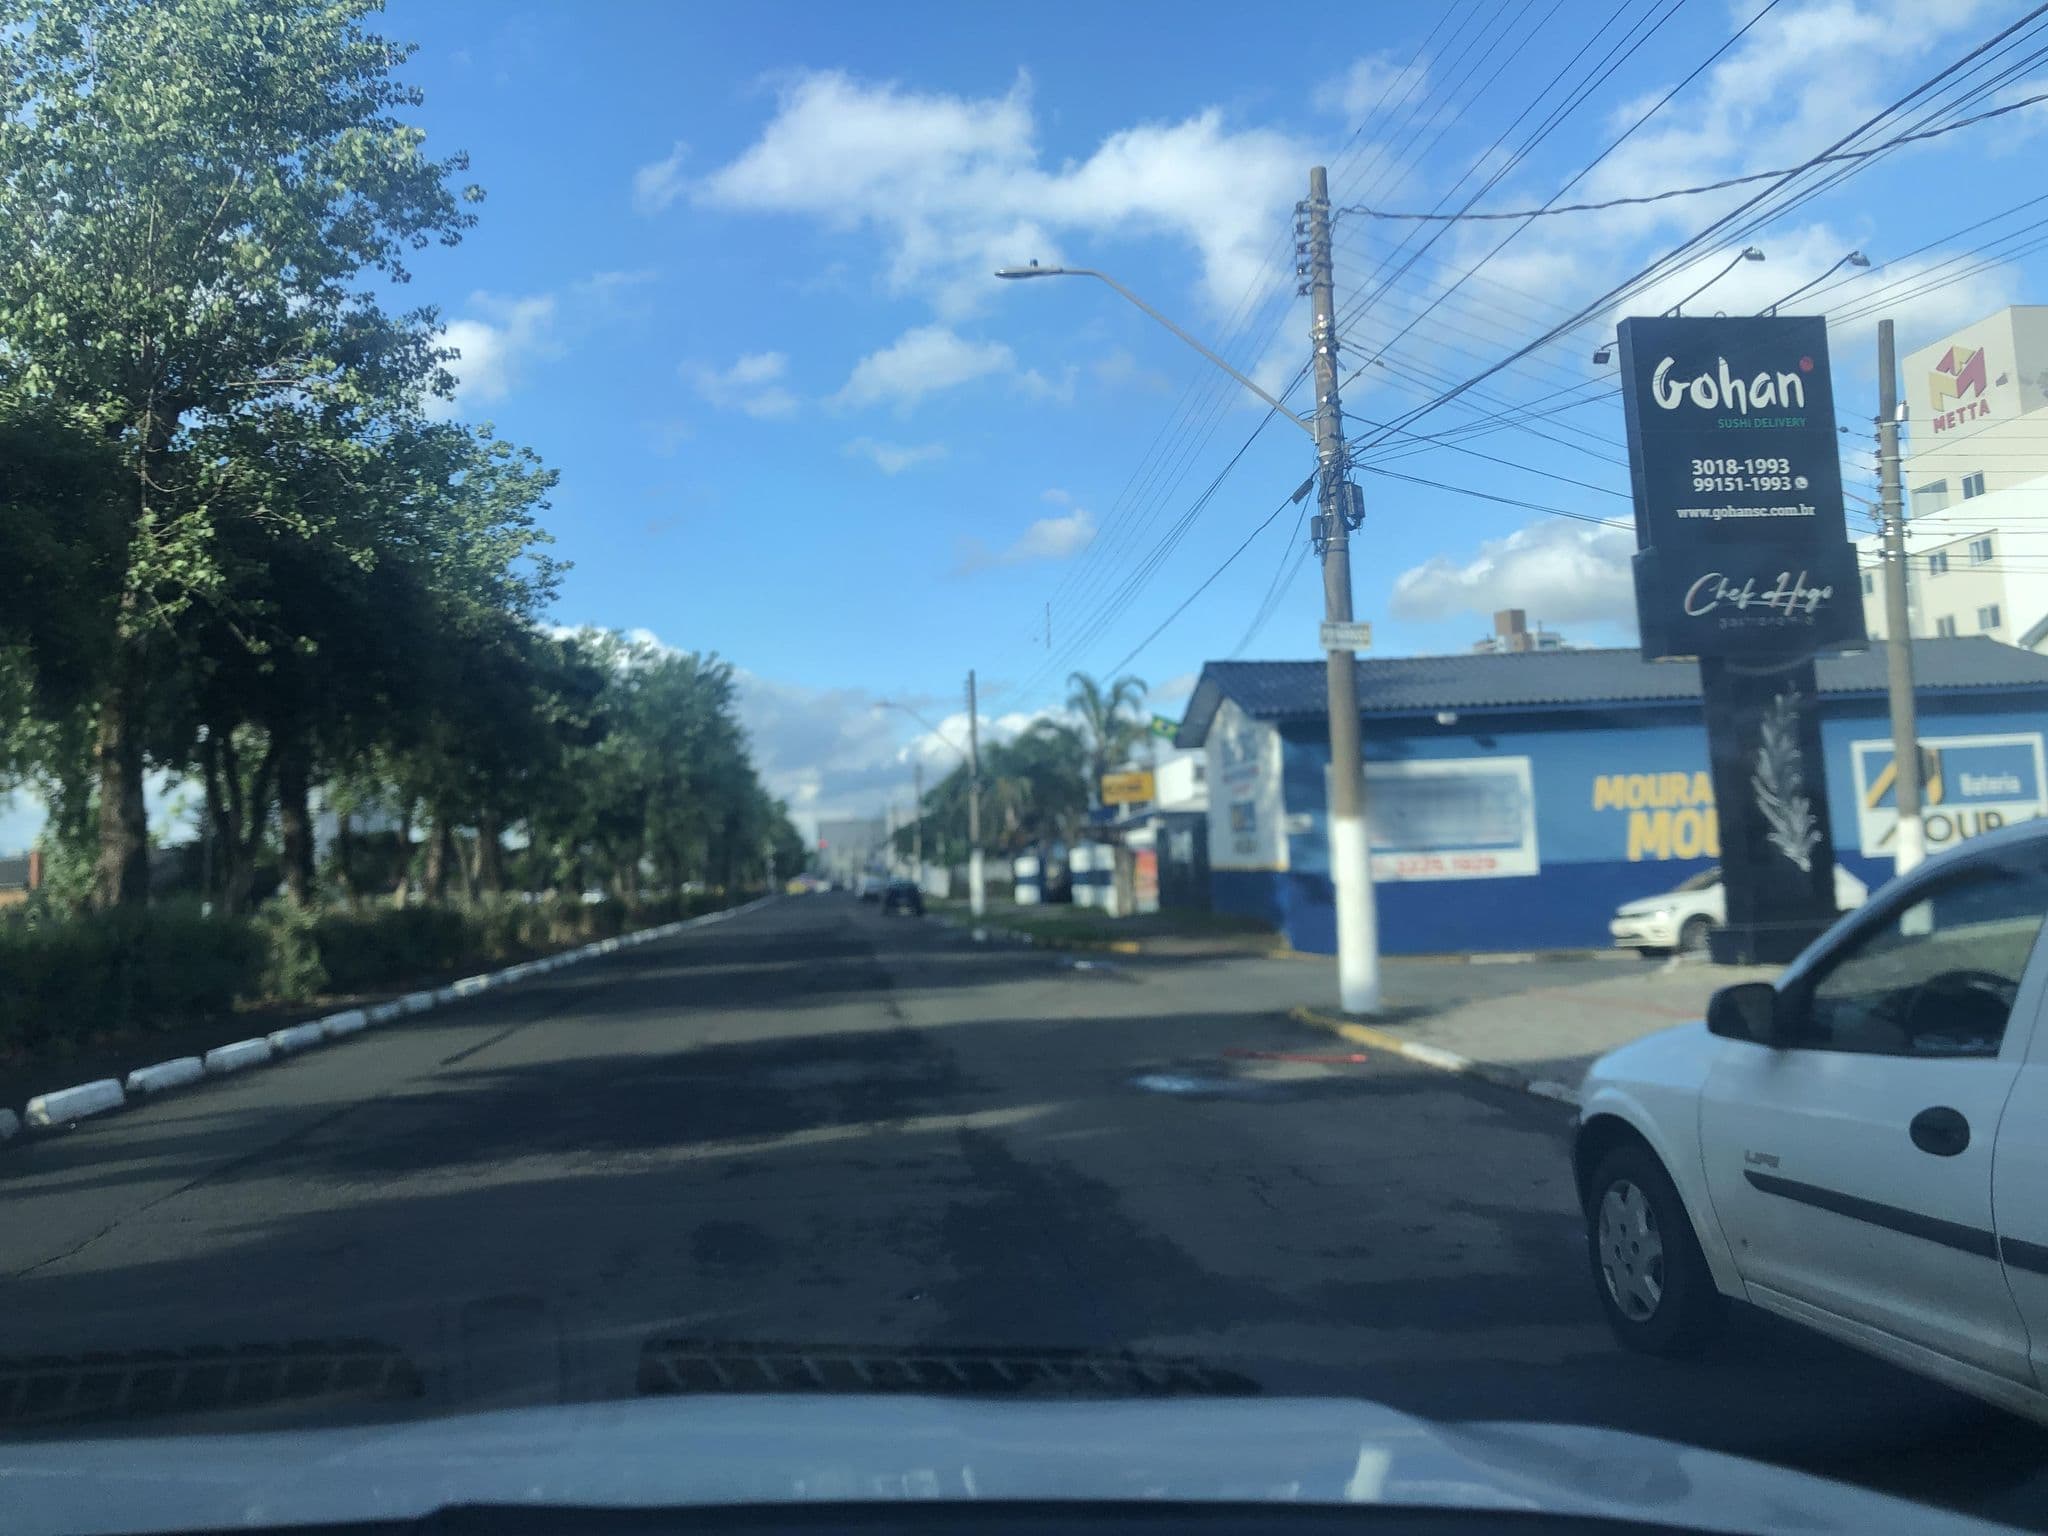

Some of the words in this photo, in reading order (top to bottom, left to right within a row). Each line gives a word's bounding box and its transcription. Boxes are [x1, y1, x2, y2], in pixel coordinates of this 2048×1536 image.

[1652, 356, 1806, 415] Gohan
[1718, 417, 1752, 429] SUSHI
[1753, 416, 1807, 429] DELIVERY
[1932, 398, 1991, 434] METTA
[1691, 458, 1791, 475] 3018-1993
[1693, 476, 1792, 492] 99151-1993
[1676, 503, 1816, 521] www.gohansc.com.br
[1684, 572, 1757, 617] Chef
[1593, 770, 1715, 811] MOURA
